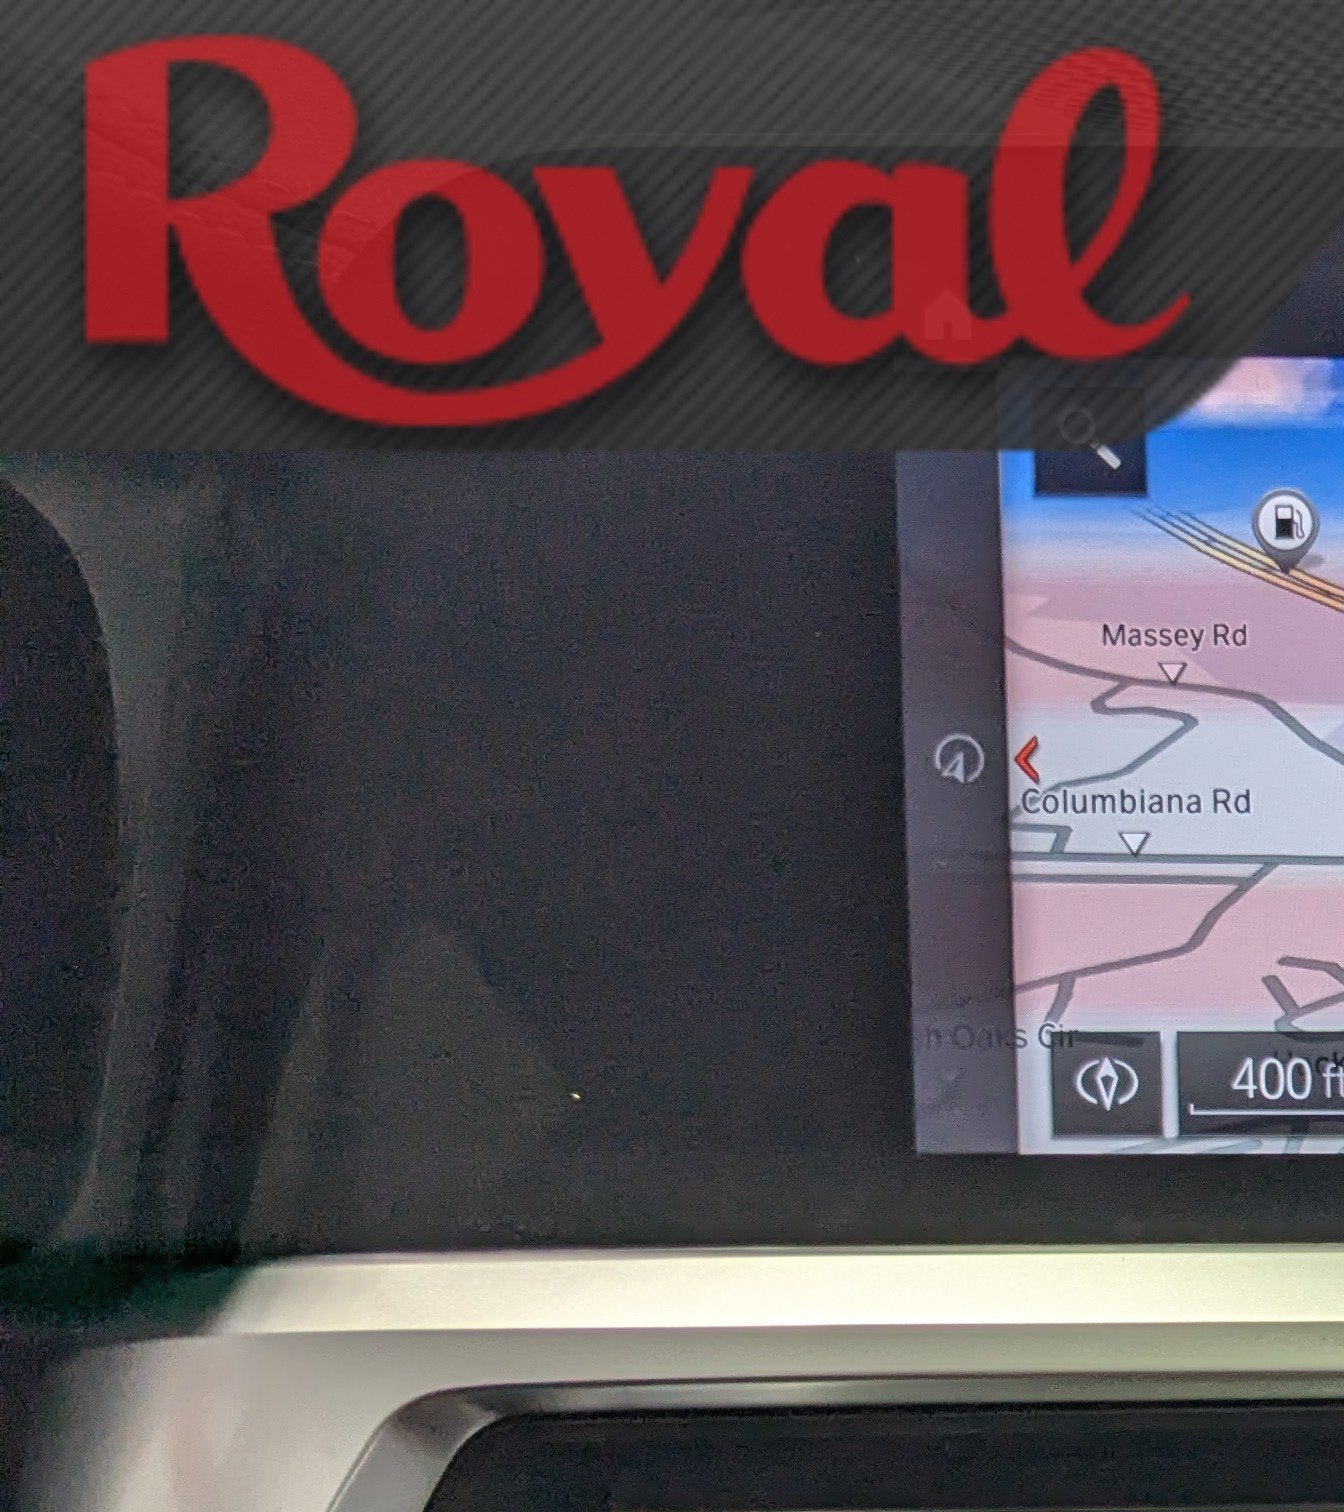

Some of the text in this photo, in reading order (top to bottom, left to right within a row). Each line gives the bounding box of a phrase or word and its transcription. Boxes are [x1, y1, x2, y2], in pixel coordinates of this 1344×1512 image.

[1102, 624, 1247, 651] Massey Rd
[1021, 789, 1251, 815] Columbiana Rd
[1232, 1057, 1312, 1100] 400
